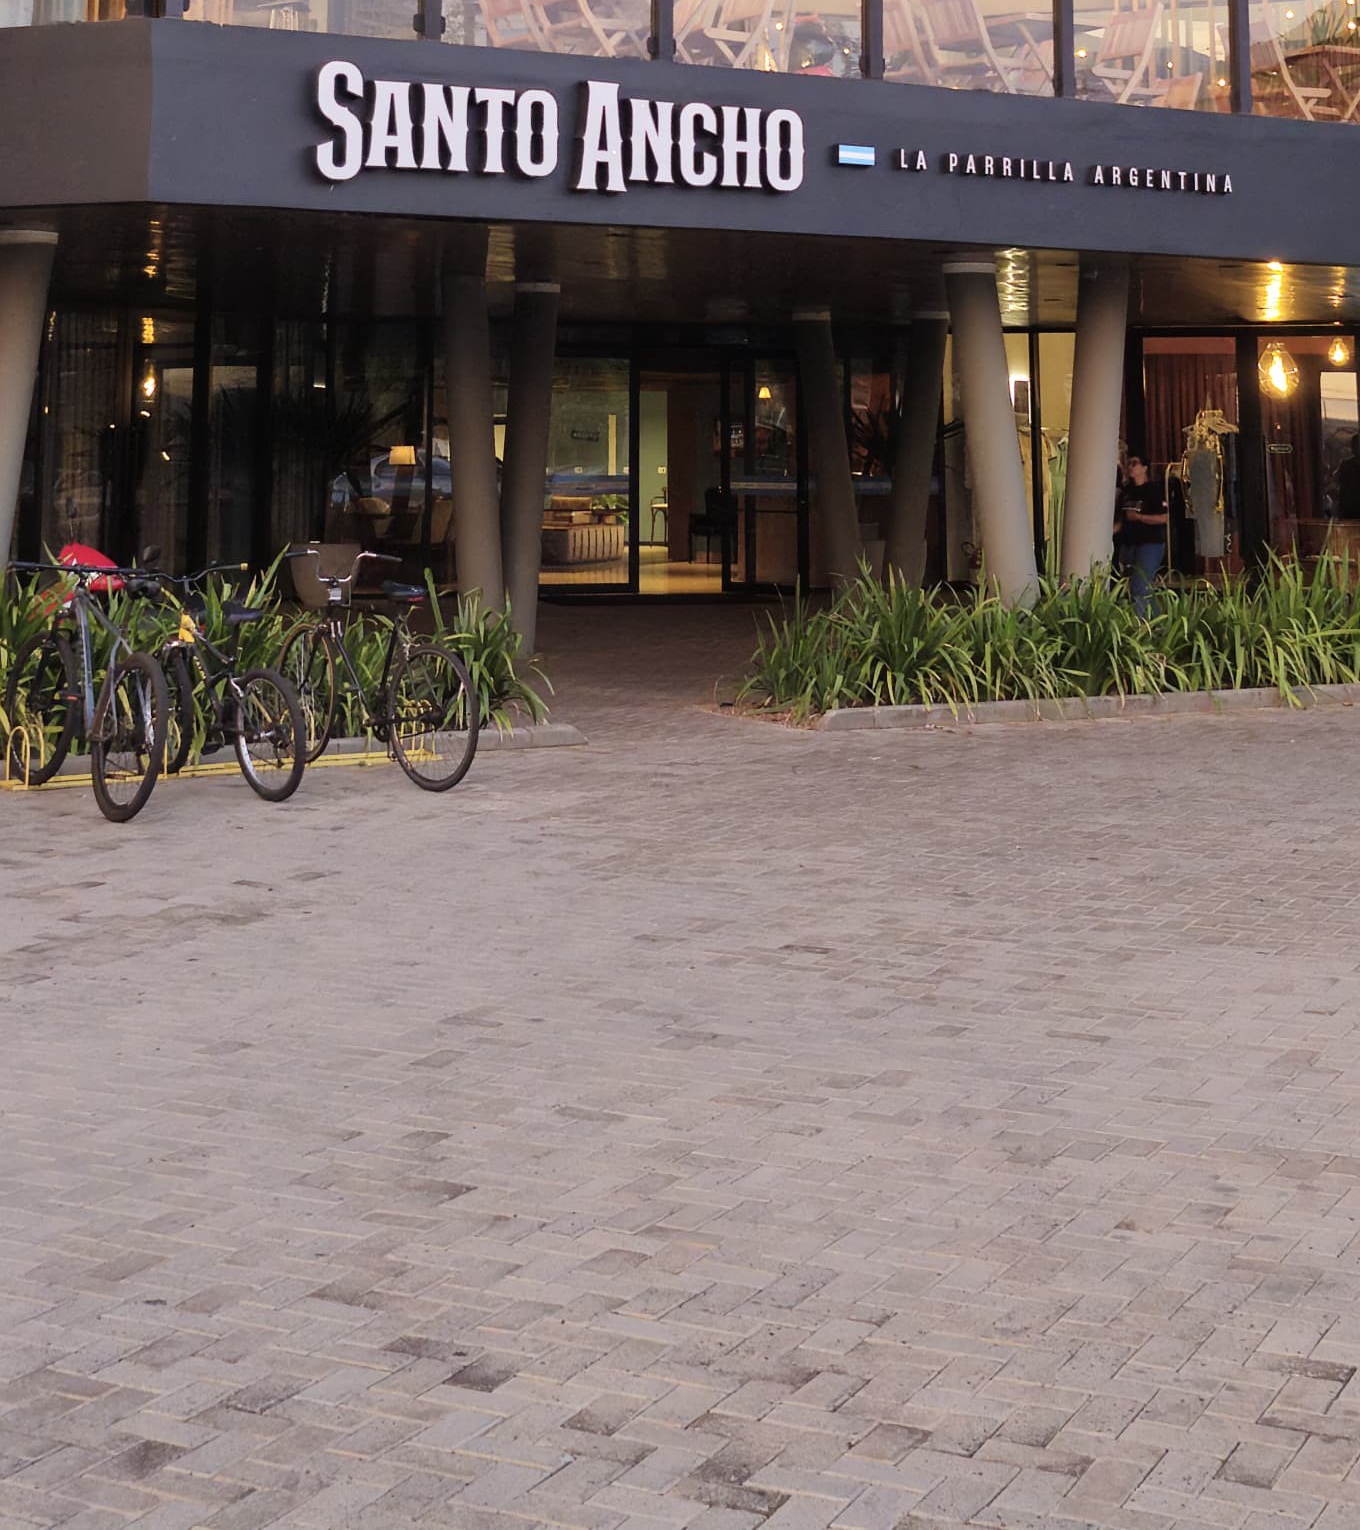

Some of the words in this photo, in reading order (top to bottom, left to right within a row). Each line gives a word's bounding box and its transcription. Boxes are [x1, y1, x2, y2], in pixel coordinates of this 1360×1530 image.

[316, 60, 559, 181] SANTO
[576, 80, 805, 192] ANCHO
[899, 148, 928, 170] LA
[948, 153, 1074, 182] PARRILLA
[1094, 164, 1233, 194] ARGENTINA
